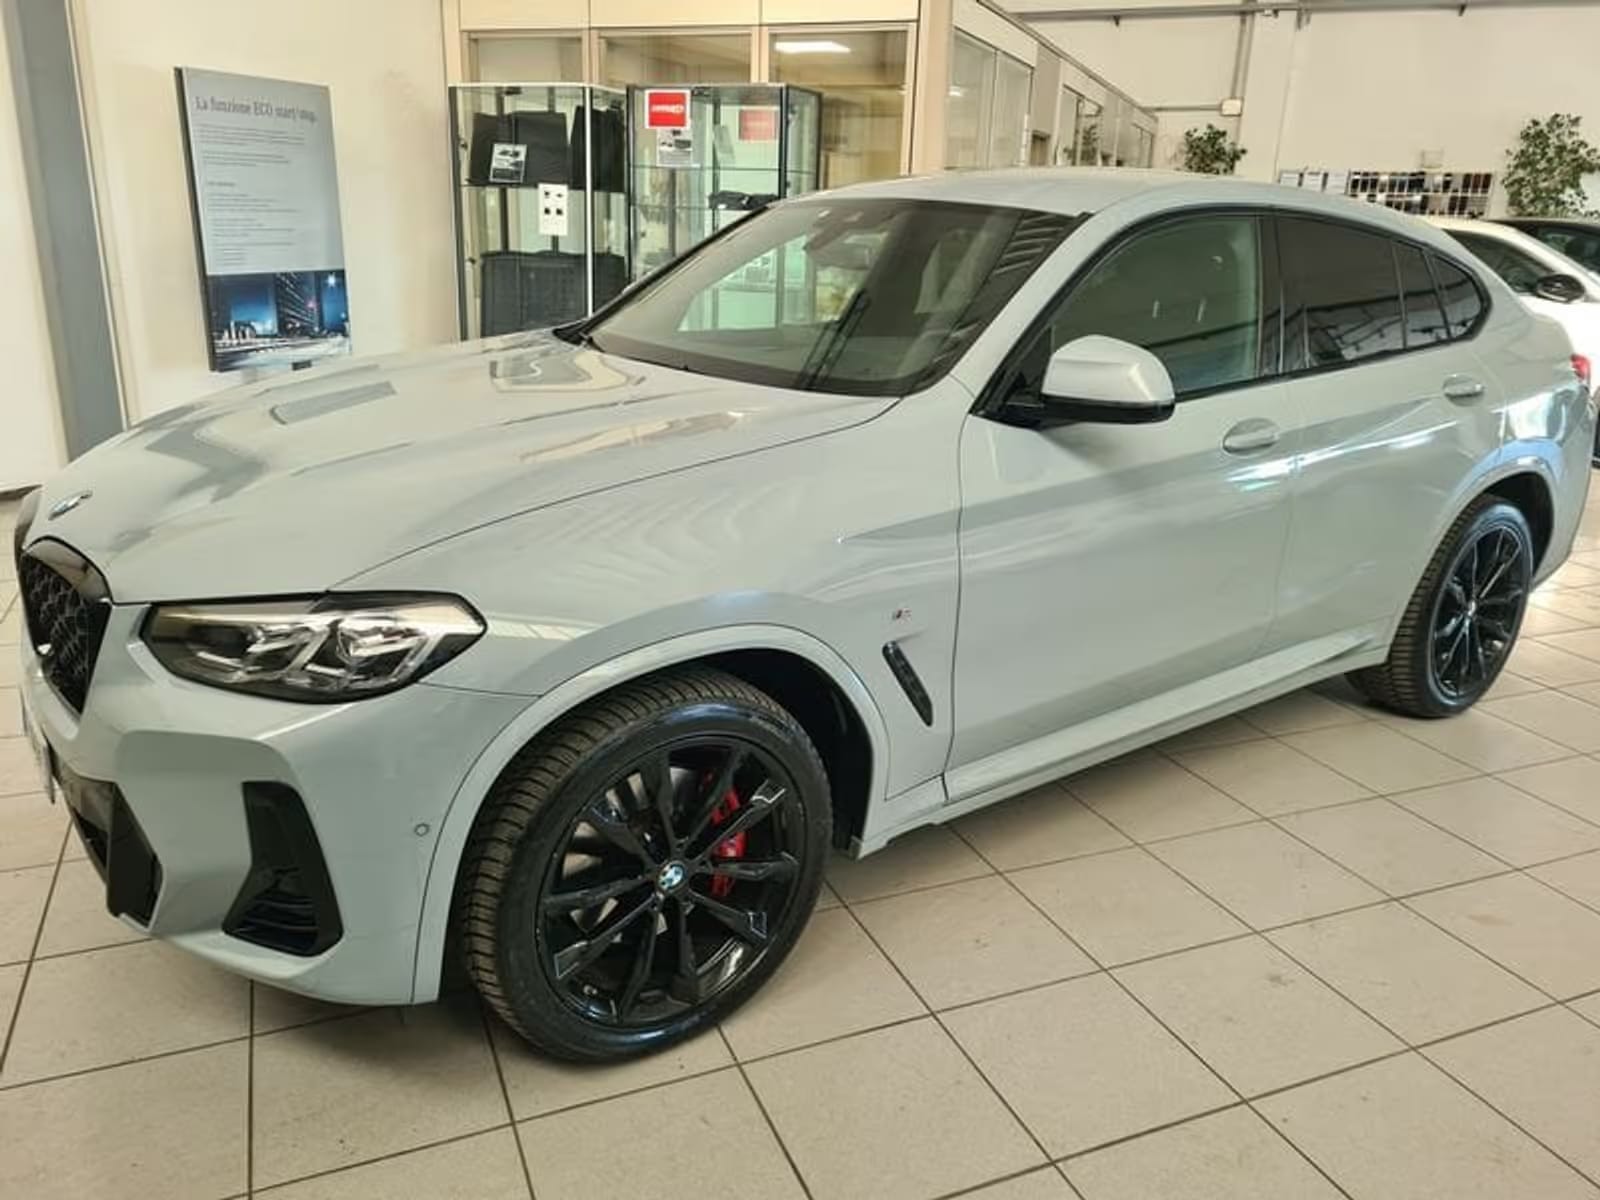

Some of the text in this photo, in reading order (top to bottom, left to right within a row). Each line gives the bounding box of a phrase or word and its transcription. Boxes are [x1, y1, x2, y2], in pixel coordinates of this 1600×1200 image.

[195, 96, 208, 111] La
[210, 96, 251, 115] funzione
[253, 101, 273, 117] ECO
